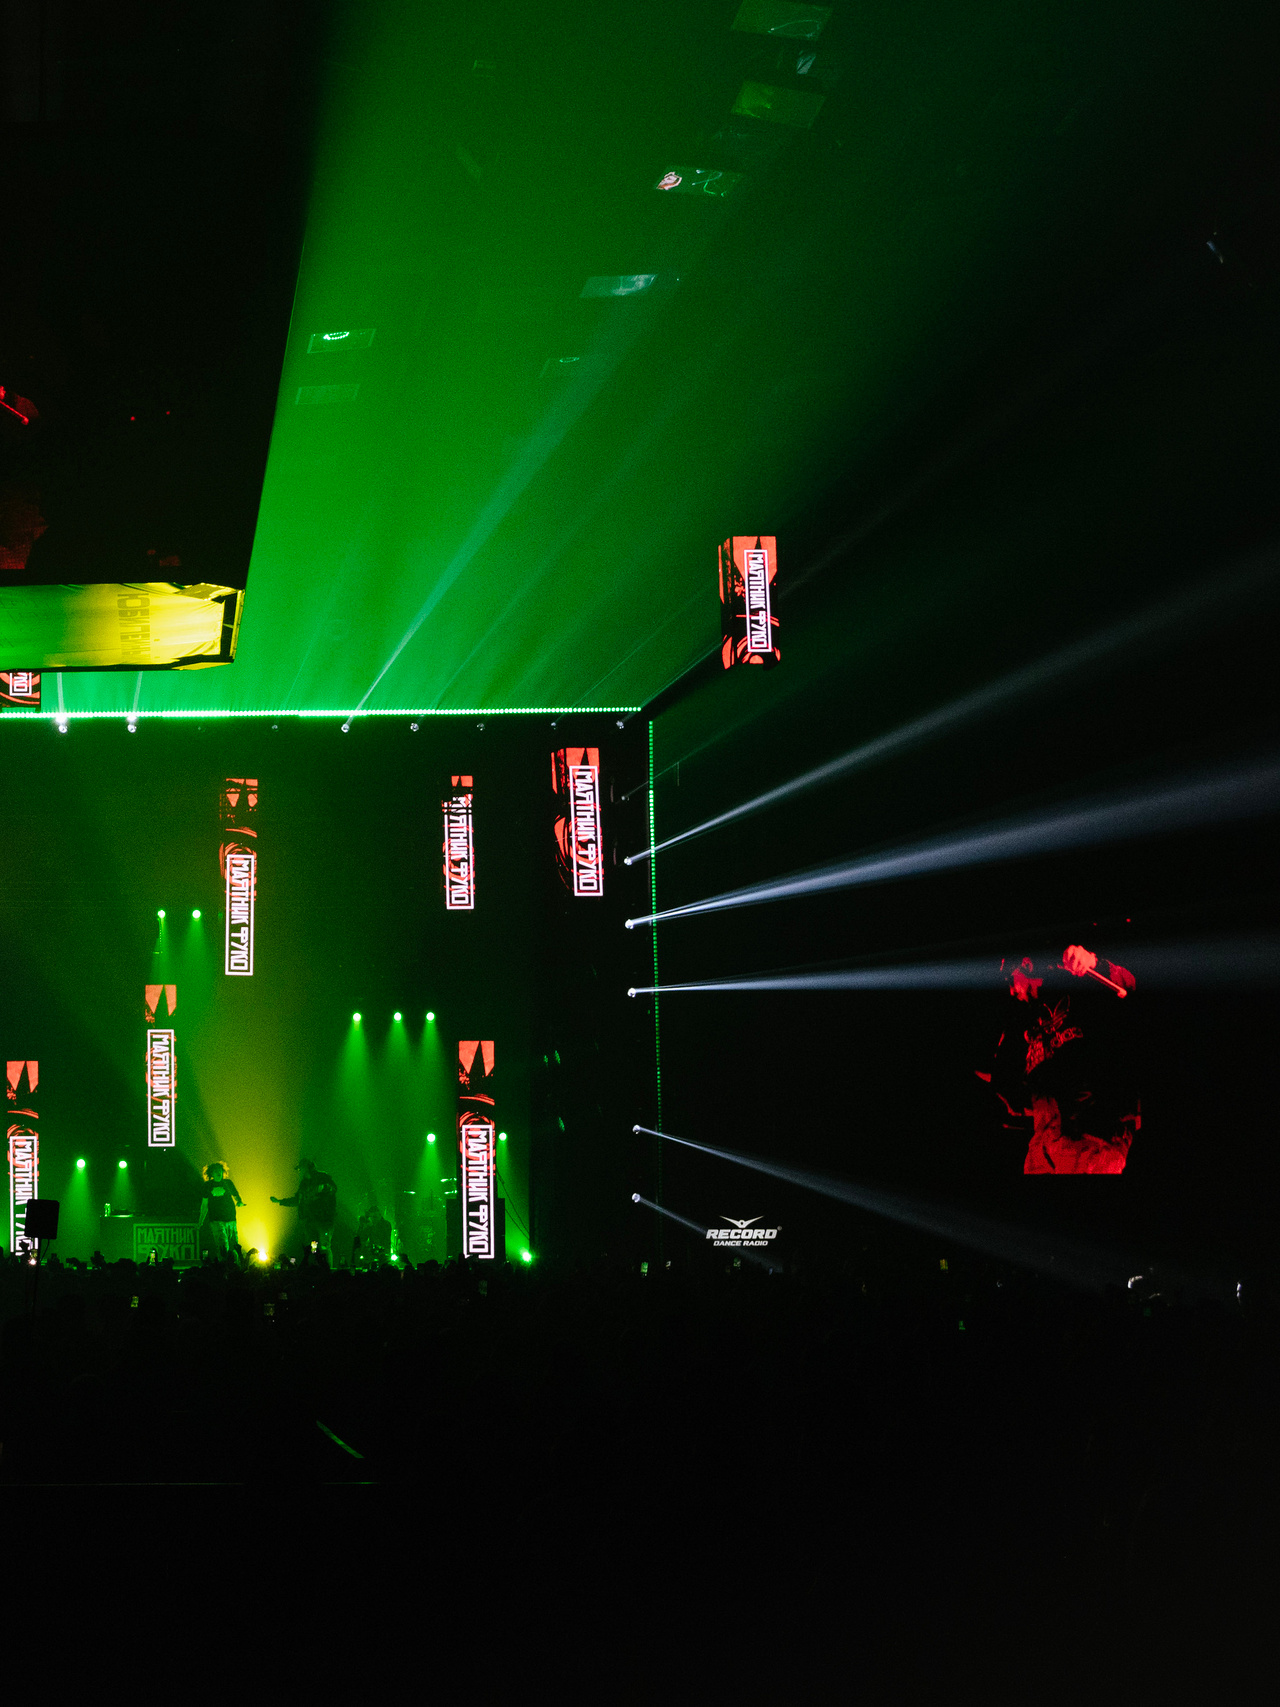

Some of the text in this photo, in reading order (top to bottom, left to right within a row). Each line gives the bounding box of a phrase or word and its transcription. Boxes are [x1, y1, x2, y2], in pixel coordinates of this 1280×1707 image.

[748, 554, 767, 647] МАЯТНИК ФУКО
[575, 772, 597, 890] МАЯТНИК ФУКО
[230, 860, 249, 970] МАЯТНИК ФУКО
[451, 862, 469, 904] ФУКО
[153, 1035, 170, 1141] МАЯТНИК ФУКО
[15, 1141, 32, 1205] МАЯТНИК
[468, 1131, 488, 1252] МАЯТНИК ФУКО
[706, 1229, 778, 1239] RECORD
